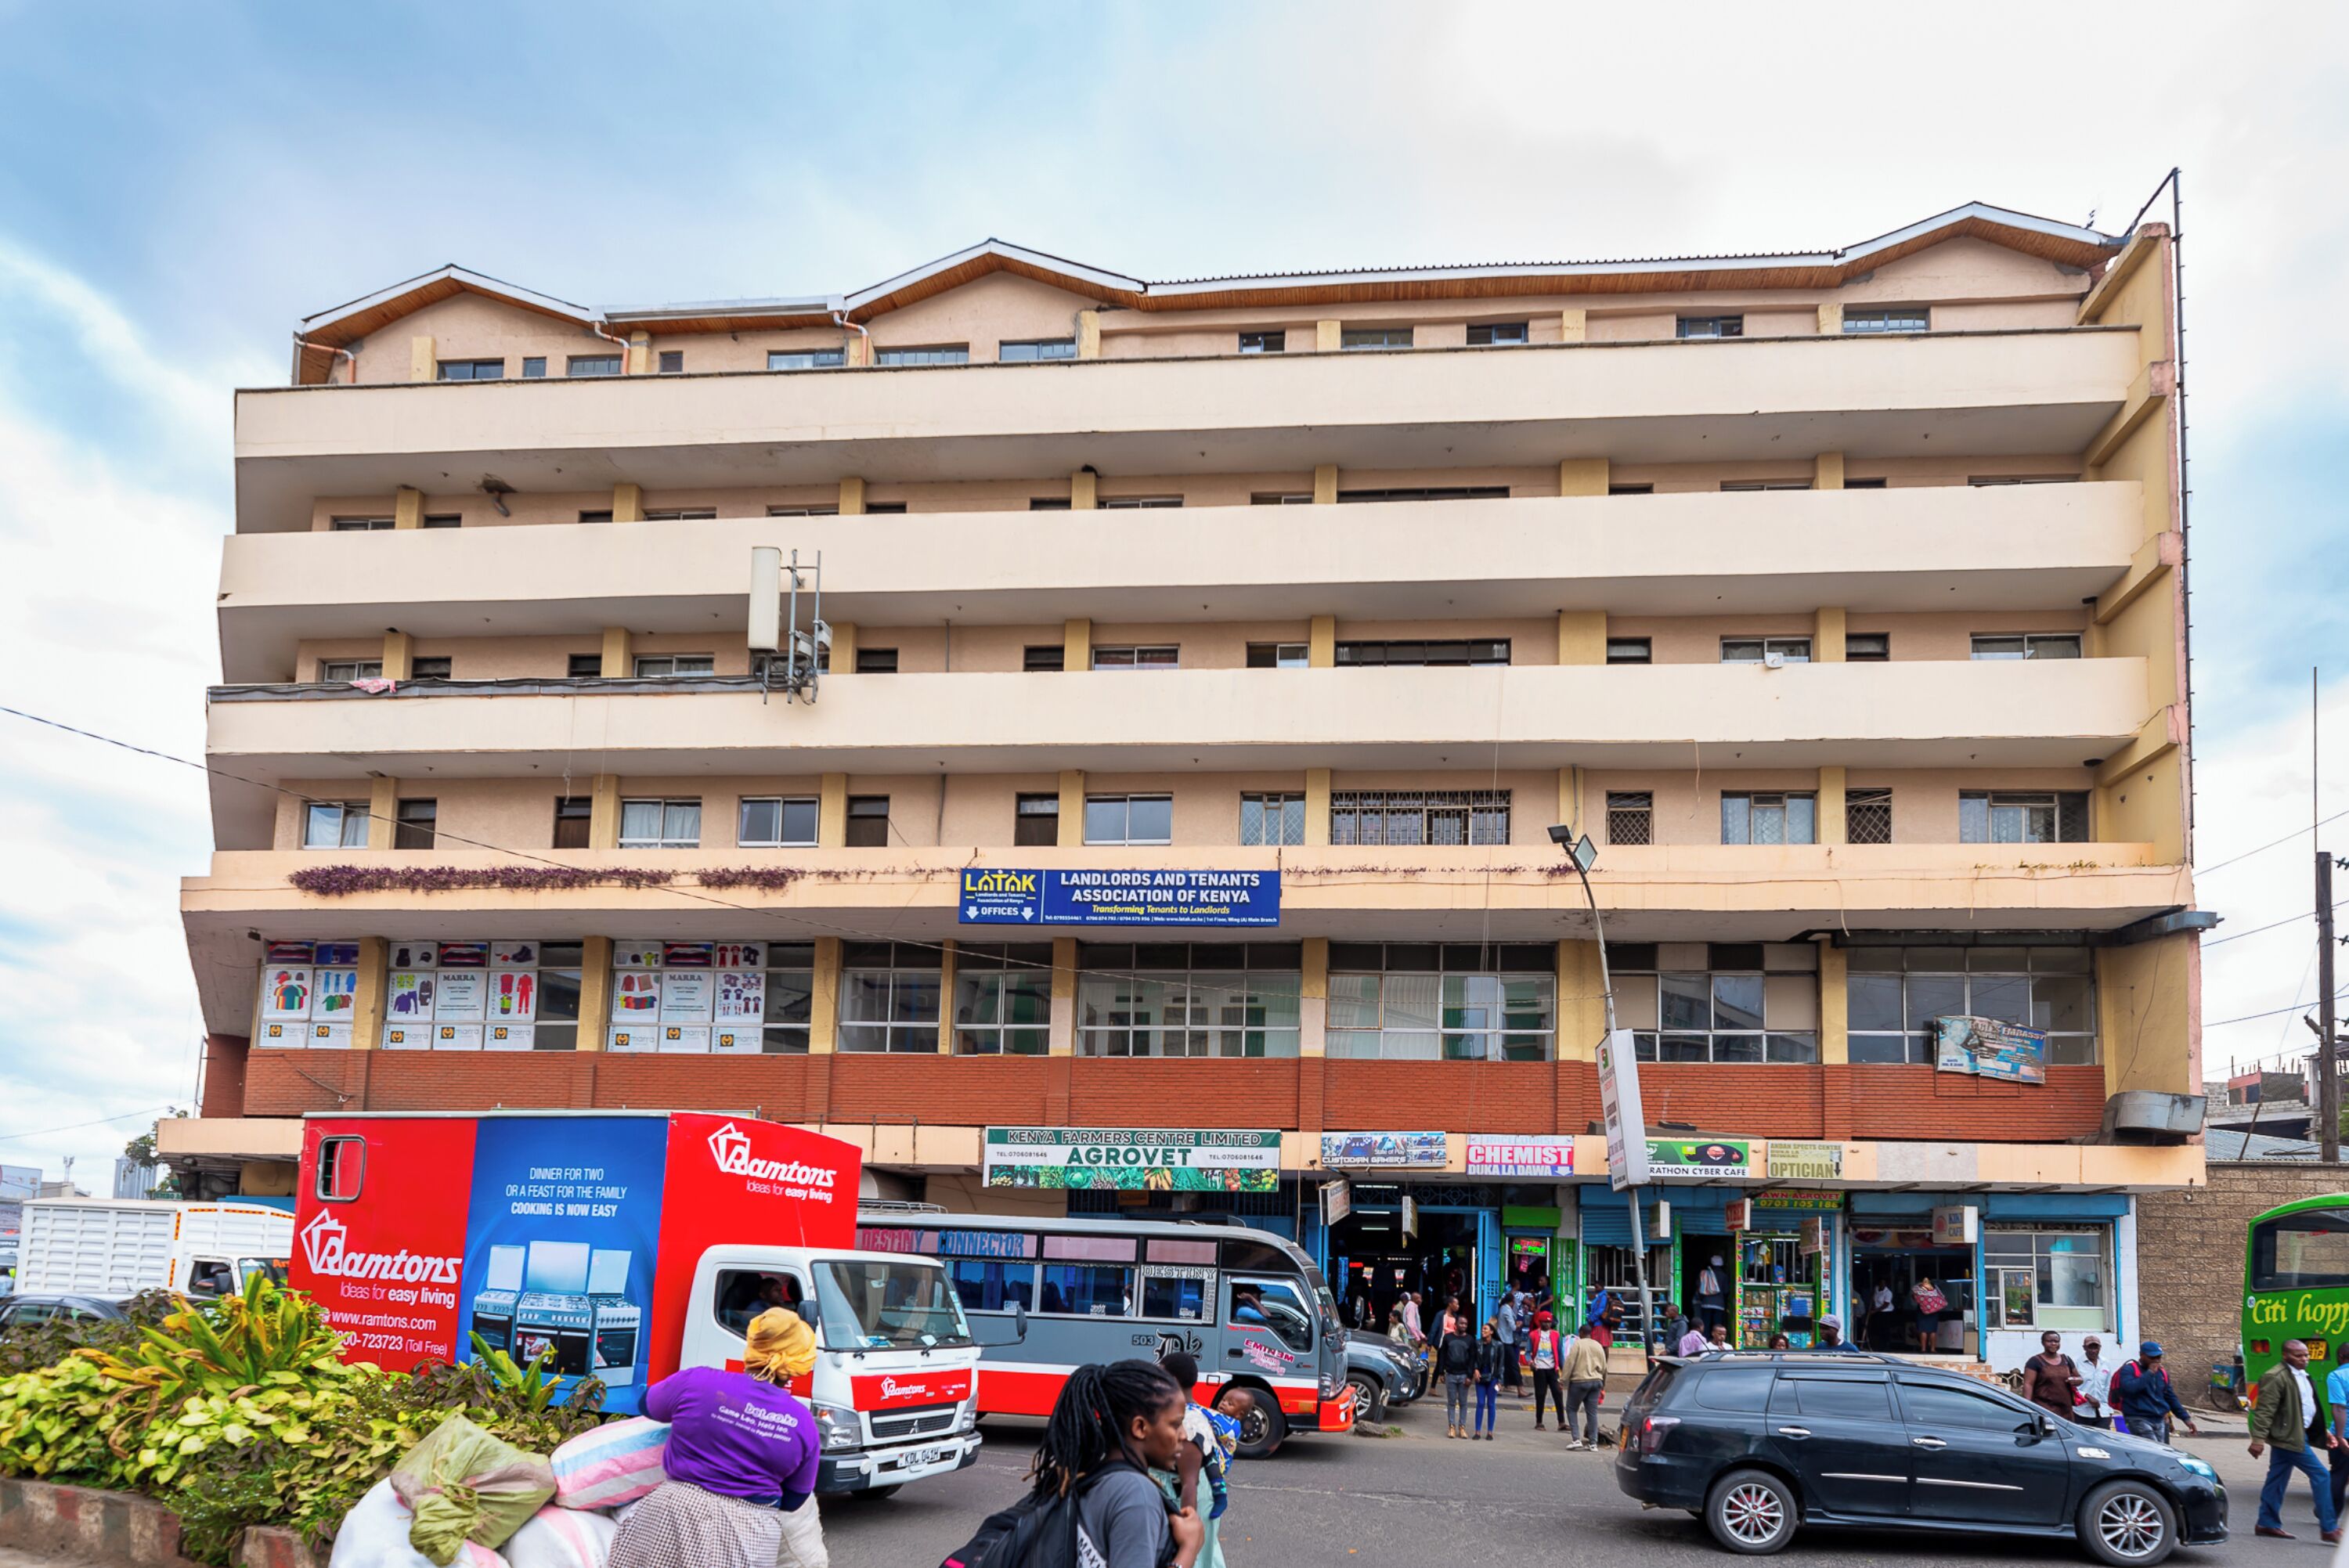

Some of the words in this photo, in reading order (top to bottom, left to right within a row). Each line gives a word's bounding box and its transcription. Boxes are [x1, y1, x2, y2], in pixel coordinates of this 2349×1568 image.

[965, 871, 1036, 892] LATAK
[1060, 873, 1151, 886] LANDLORDS
[1153, 873, 1186, 886] AND
[1189, 874, 1261, 887] TENANTS
[1072, 889, 1174, 902] ASSOCIATION
[1177, 889, 1196, 902] OF
[1200, 890, 1250, 903] KENYA
[1092, 905, 1144, 914] Transforming
[1146, 905, 1178, 914] Tenants
[1189, 906, 1230, 914] Landlords
[1008, 1130, 1056, 1144] KENYA
[1062, 1131, 1131, 1144] FARMERS
[1135, 1133, 1195, 1145] CENTRE
[1201, 1134, 1261, 1146] LIMITED
[1066, 1148, 1192, 1166] AGROVET
[1322, 1156, 1369, 1165] CUSTODIAN
[1371, 1156, 1407, 1165] GAMERS
[1468, 1146, 1572, 1164] CHEMIST
[529, 1167, 562, 1180] DINNER
[564, 1168, 582, 1181] FOR
[583, 1168, 604, 1181] TWO
[725, 1144, 838, 1188] Ramtons
[1468, 1164, 1500, 1175] DUKA
[1502, 1165, 1516, 1175] LA
[1517, 1165, 1553, 1176] DAWA
[1770, 1162, 1834, 1178] OPTICIAN
[506, 1184, 518, 1196] OR
[519, 1185, 526, 1196] A
[528, 1185, 555, 1198] FEAST
[557, 1185, 574, 1198] FOR
[576, 1186, 594, 1199] THE
[595, 1187, 628, 1199] FAMILY
[746, 1180, 770, 1194] Ideas
[773, 1184, 785, 1195] for
[785, 1188, 808, 1200] easy
[809, 1188, 833, 1204] living
[511, 1202, 553, 1215] COOKING
[554, 1203, 565, 1216] IS
[567, 1203, 590, 1217] NOW
[591, 1204, 618, 1217] EASY
[862, 1227, 924, 1253] DESTINY
[937, 1230, 1025, 1258] CONNECTOR
[316, 1236, 463, 1284] Ramtons
[1142, 1266, 1217, 1279] DESTINY
[340, 1282, 370, 1299] Ideas
[372, 1283, 387, 1300] for
[388, 1289, 418, 1306] easy
[420, 1287, 456, 1309] living
[2253, 1298, 2288, 1325] Citi
[332, 1310, 437, 1331] www.ramtons.com
[406, 1339, 423, 1353] (Toll
[424, 1340, 448, 1357] Free)
[1132, 1335, 1154, 1346] 503
[904, 1453, 919, 1465] KDL
